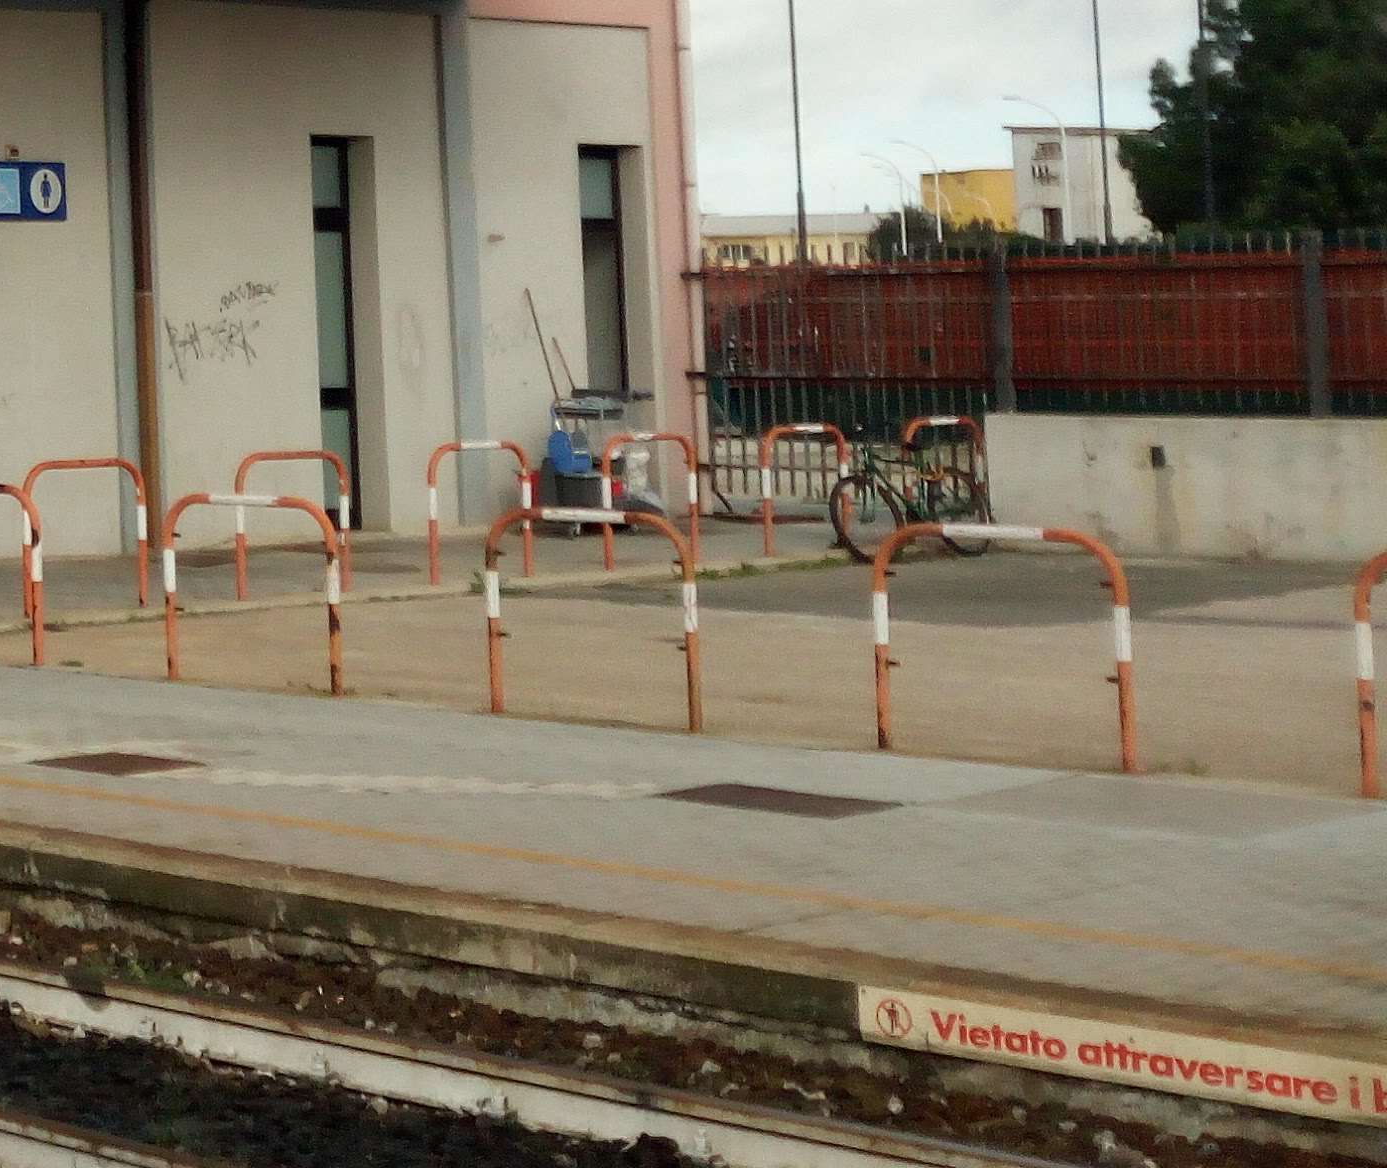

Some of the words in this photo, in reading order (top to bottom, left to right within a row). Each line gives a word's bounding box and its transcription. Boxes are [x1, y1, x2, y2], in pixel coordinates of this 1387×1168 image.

[929, 1008, 1068, 1062] Vietato
[1077, 1038, 1339, 1106] attraversare
[1349, 1075, 1361, 1110] i
